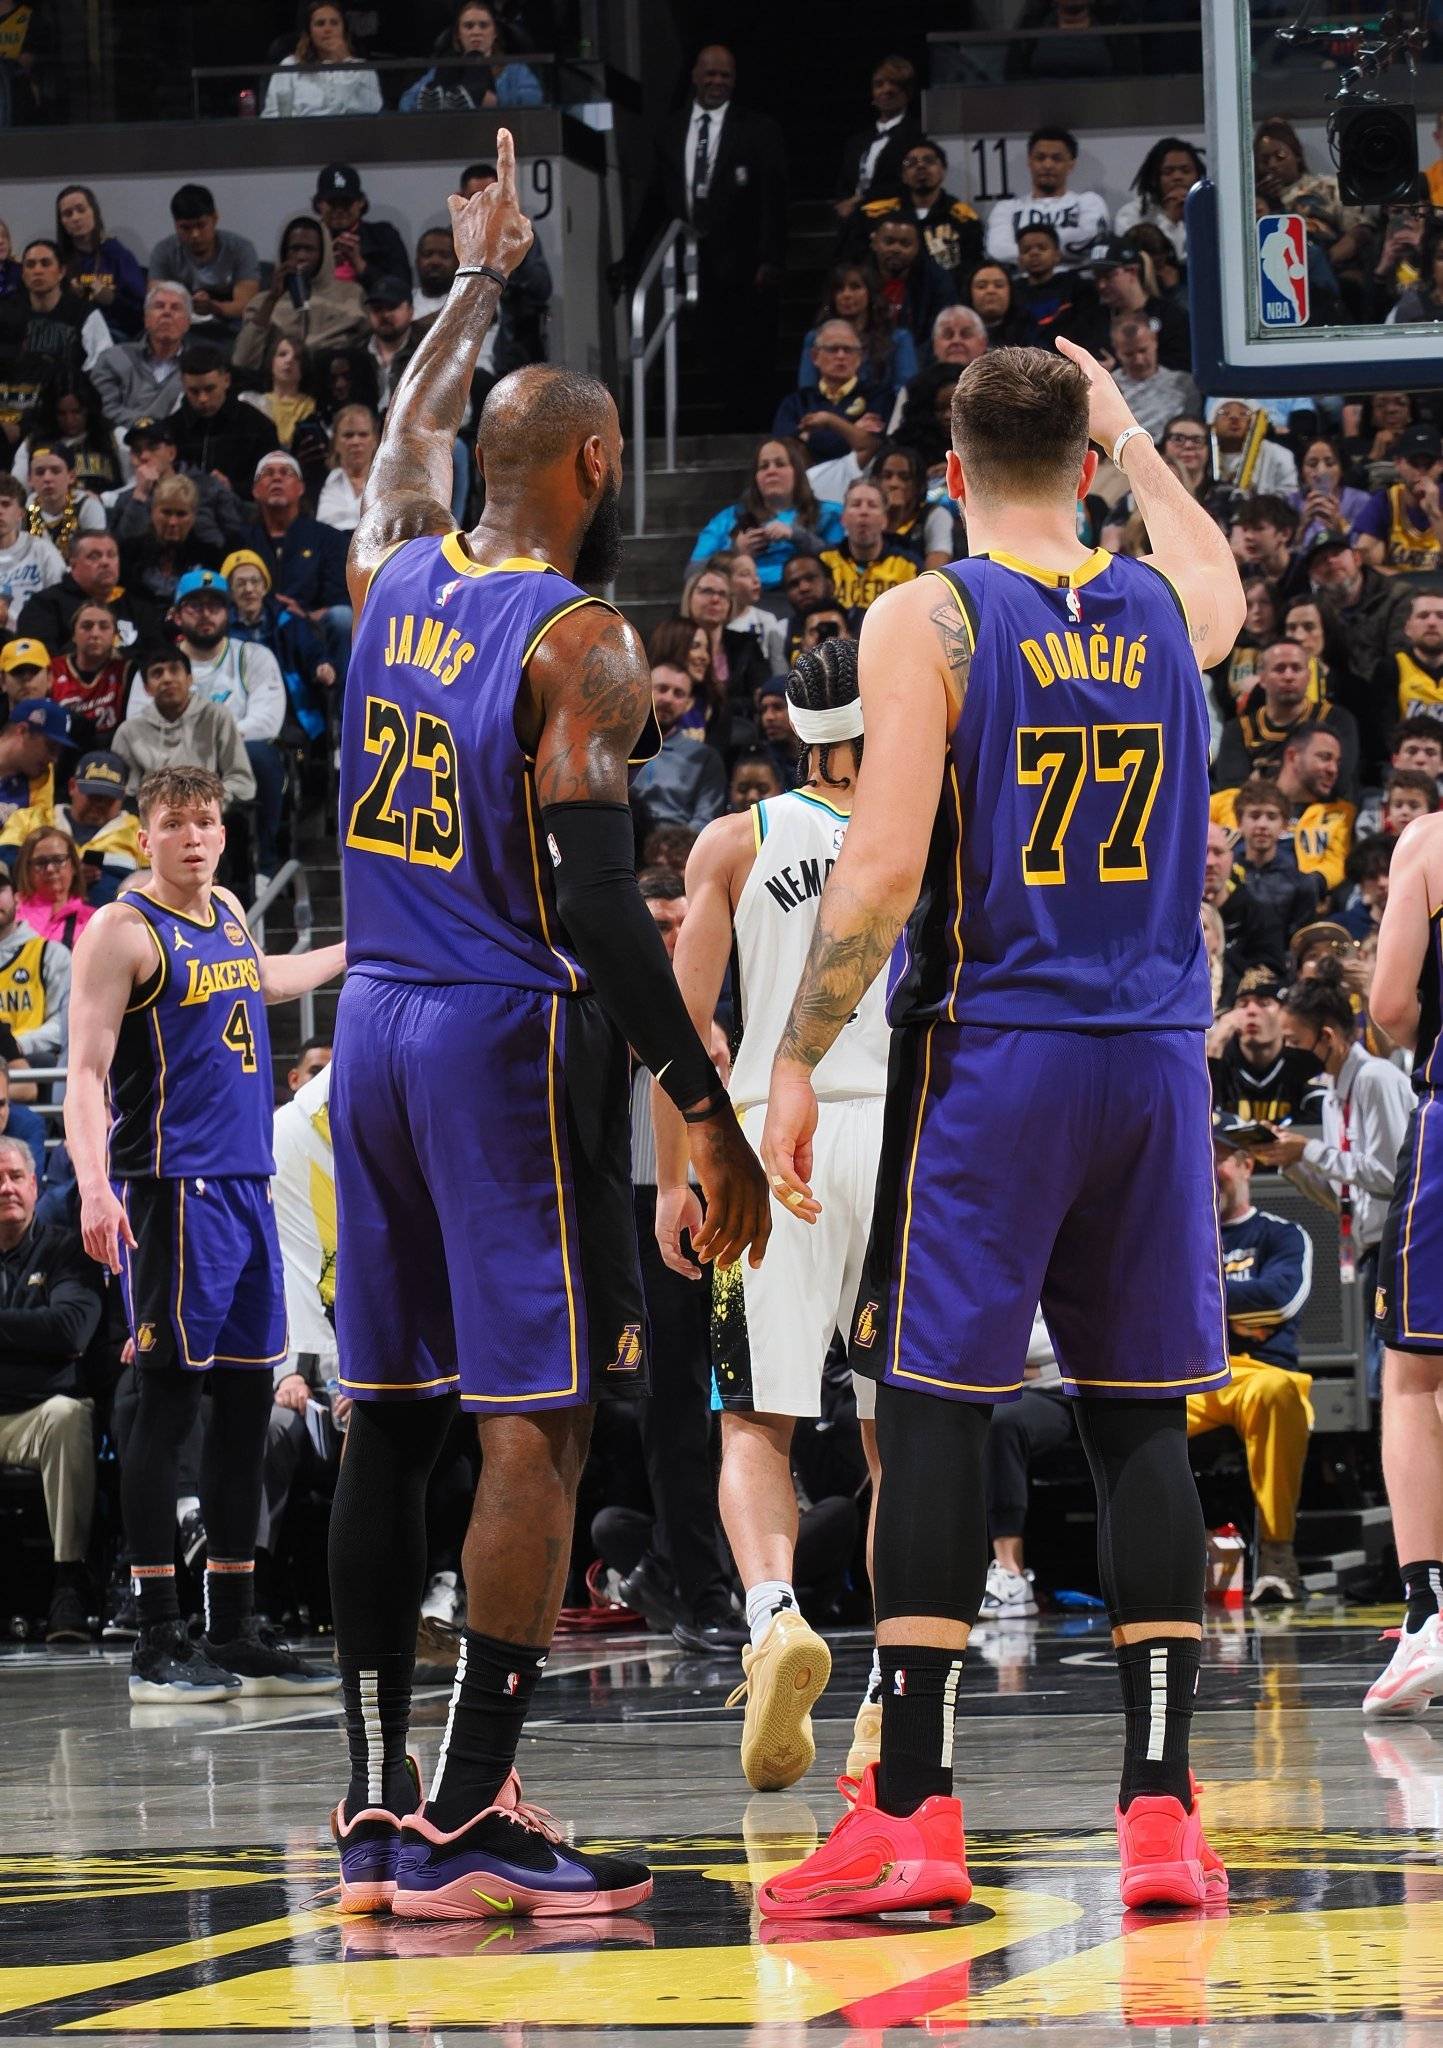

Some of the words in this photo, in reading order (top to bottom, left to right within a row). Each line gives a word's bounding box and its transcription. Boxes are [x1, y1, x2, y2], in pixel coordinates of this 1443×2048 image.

[533, 158, 552, 221] 9
[972, 138, 1016, 201] 11
[1266, 301, 1291, 320] NBA
[384, 614, 476, 686] JAMES
[1018, 623, 1148, 690] DONČIĆ
[345, 695, 464, 873] 23
[1016, 722, 1165, 887] 77
[179, 958, 261, 1008] LAKERS
[221, 999, 258, 1074] 4
